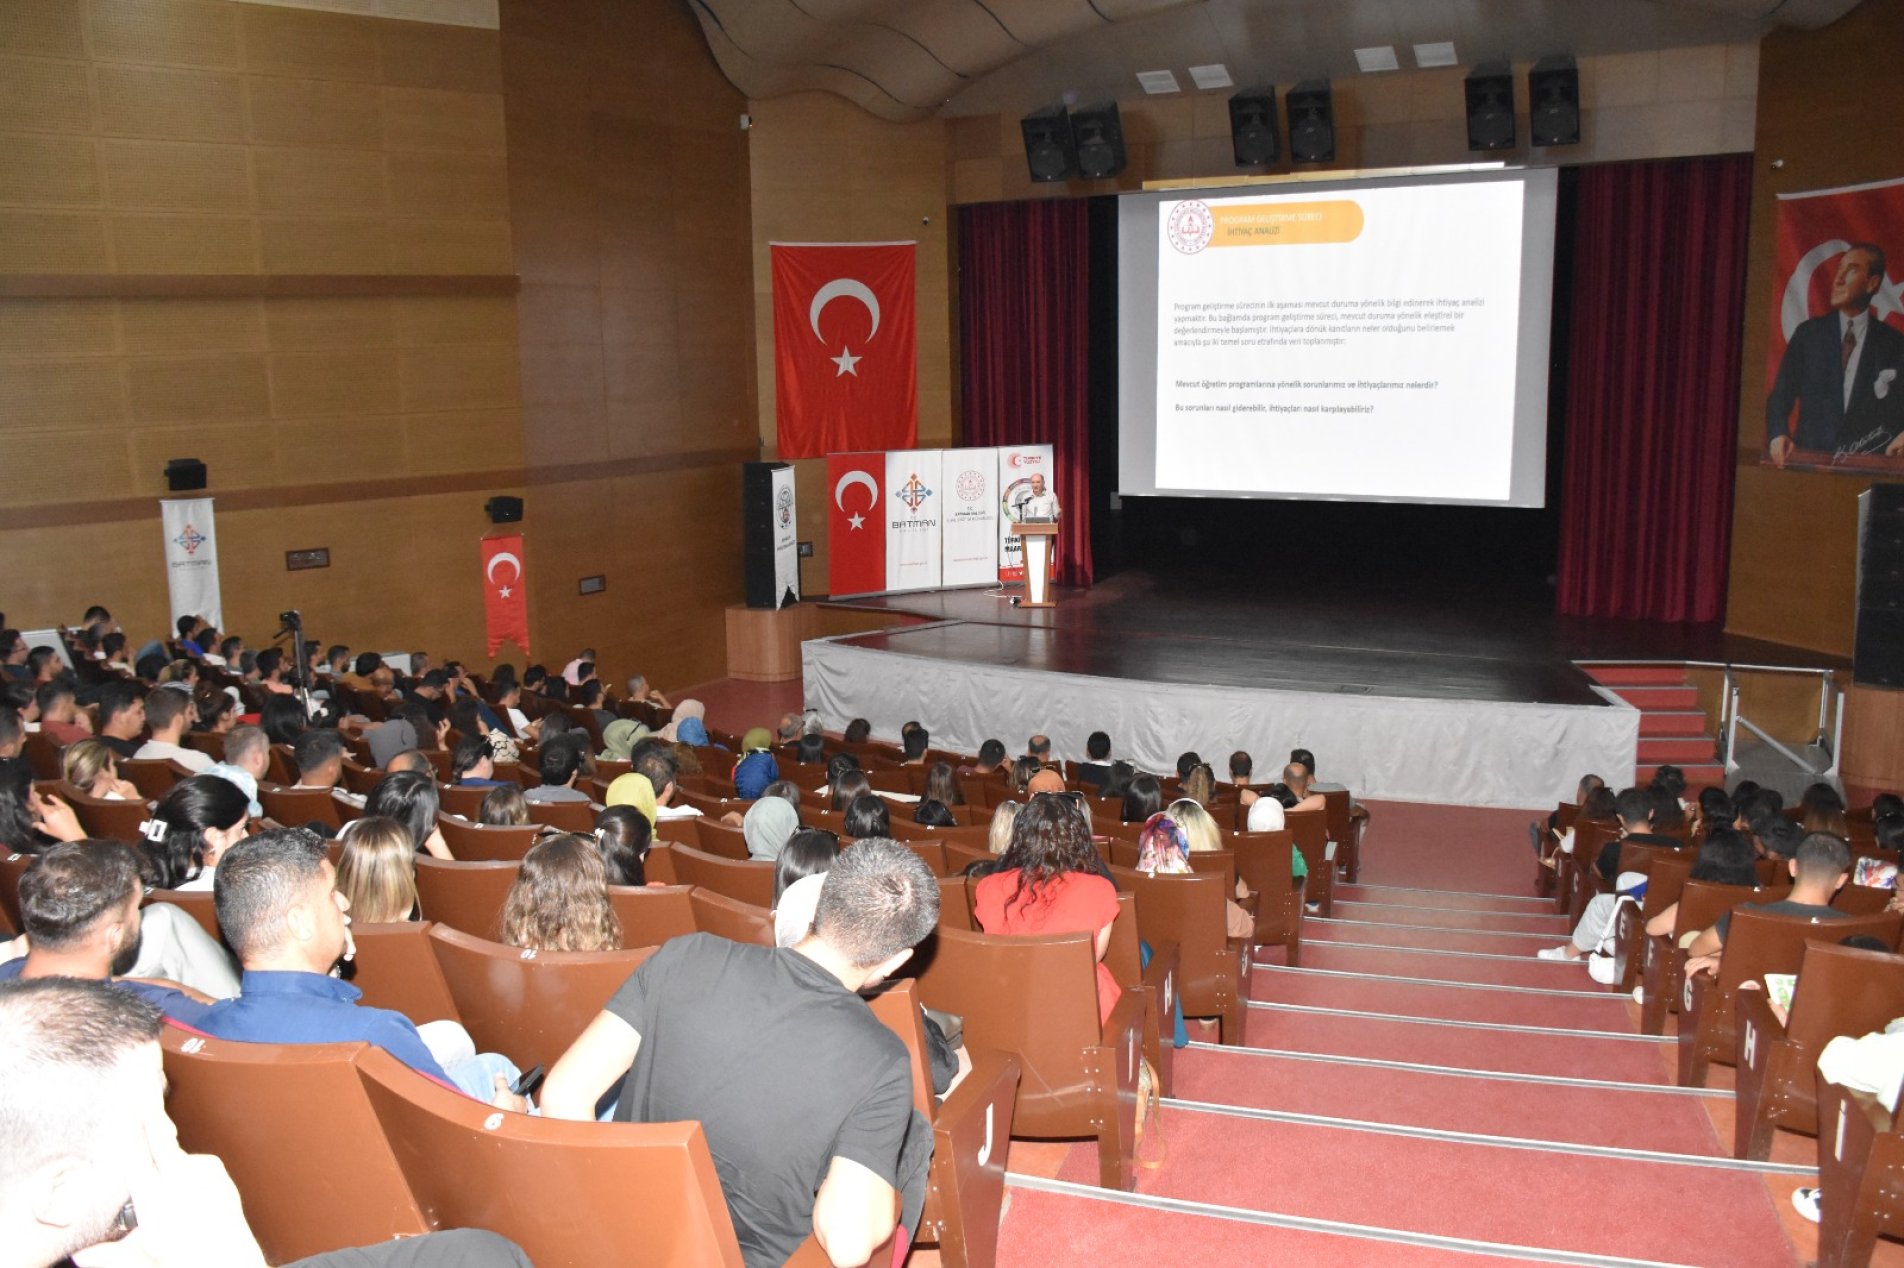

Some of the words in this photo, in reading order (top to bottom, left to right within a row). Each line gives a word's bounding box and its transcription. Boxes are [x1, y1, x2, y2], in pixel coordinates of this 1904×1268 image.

[892, 520, 936, 528] BATMAN
[180, 1037, 206, 1054] 10
[1744, 1019, 1757, 1071] H
[977, 1102, 994, 1167] J
